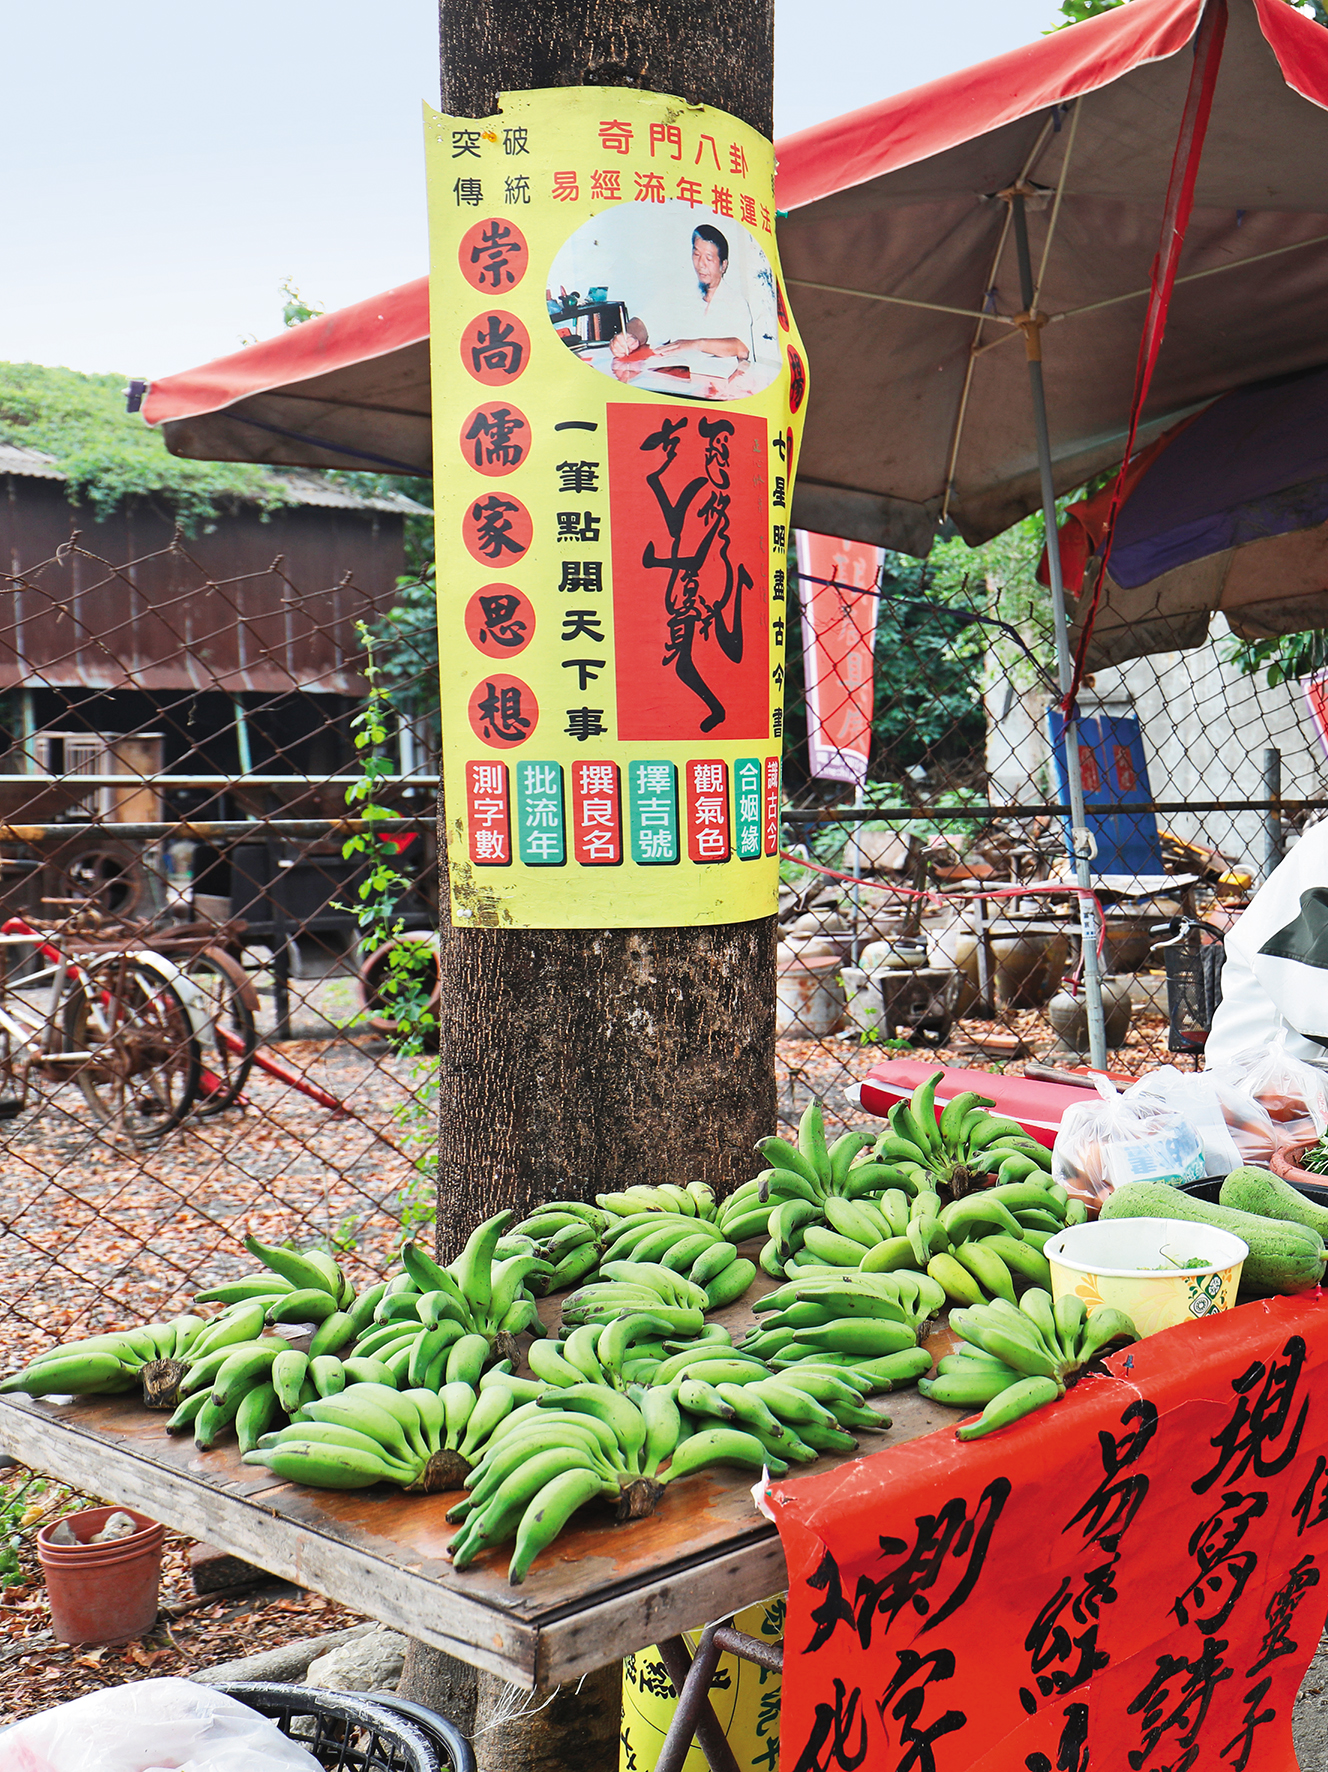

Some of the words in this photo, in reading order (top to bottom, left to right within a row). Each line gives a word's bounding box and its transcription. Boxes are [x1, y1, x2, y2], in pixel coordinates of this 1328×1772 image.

[451, 126, 530, 159] 突破
[598, 118, 750, 180] 奇門八卦
[452, 175, 531, 206] 傳統
[551, 168, 774, 237] 易經流年推運法
[464, 220, 531, 742] 崇尚儒家思想
[553, 419, 608, 742] 一筆點開天下事
[472, 764, 505, 860] 測字數
[524, 765, 559, 860] 批流年
[579, 764, 615, 859] 撰良名
[637, 764, 673, 859] 擇吉號
[692, 763, 726, 858] 觀氣色
[739, 762, 759, 854] 合姻緣
[766, 760, 779, 849] 識古今
